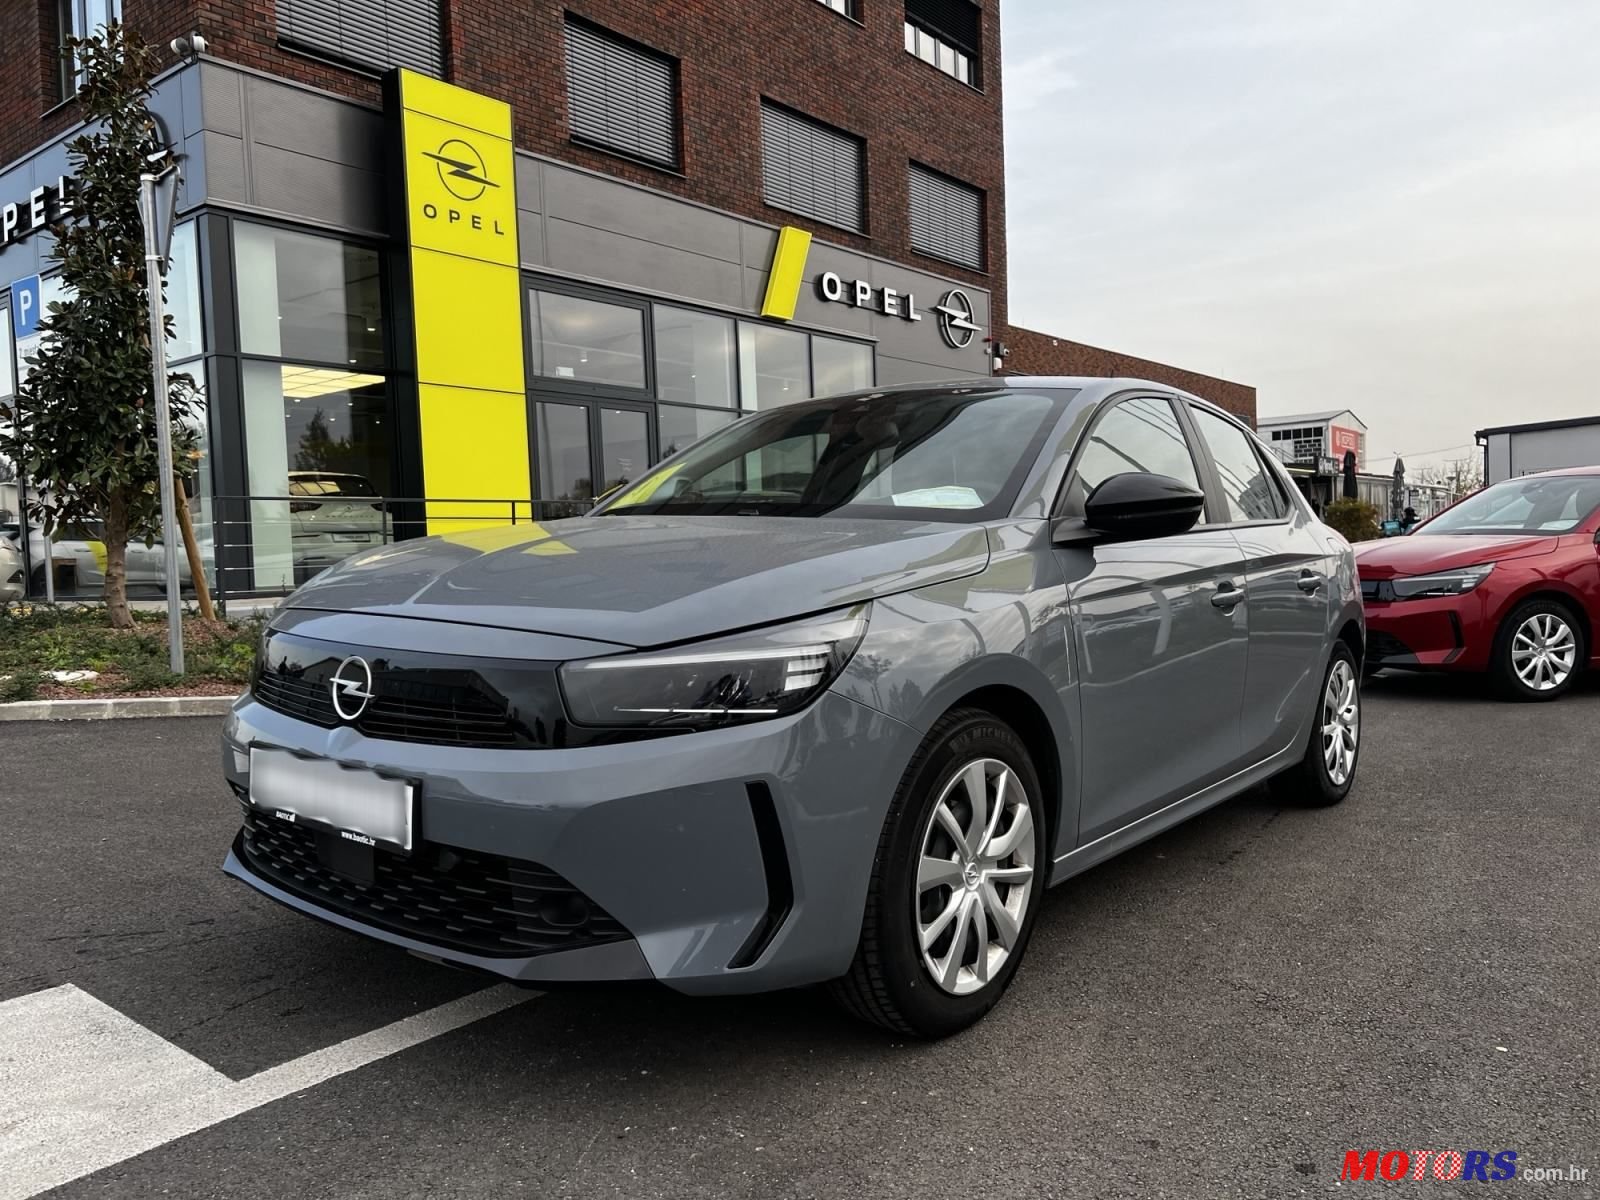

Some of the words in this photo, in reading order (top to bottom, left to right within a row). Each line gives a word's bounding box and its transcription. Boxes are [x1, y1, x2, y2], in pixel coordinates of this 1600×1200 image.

[423, 204, 504, 236] OPEL
[20, 289, 32, 326] P
[822, 271, 922, 321] OPEL
[341, 831, 376, 846] www.baotic.hr
